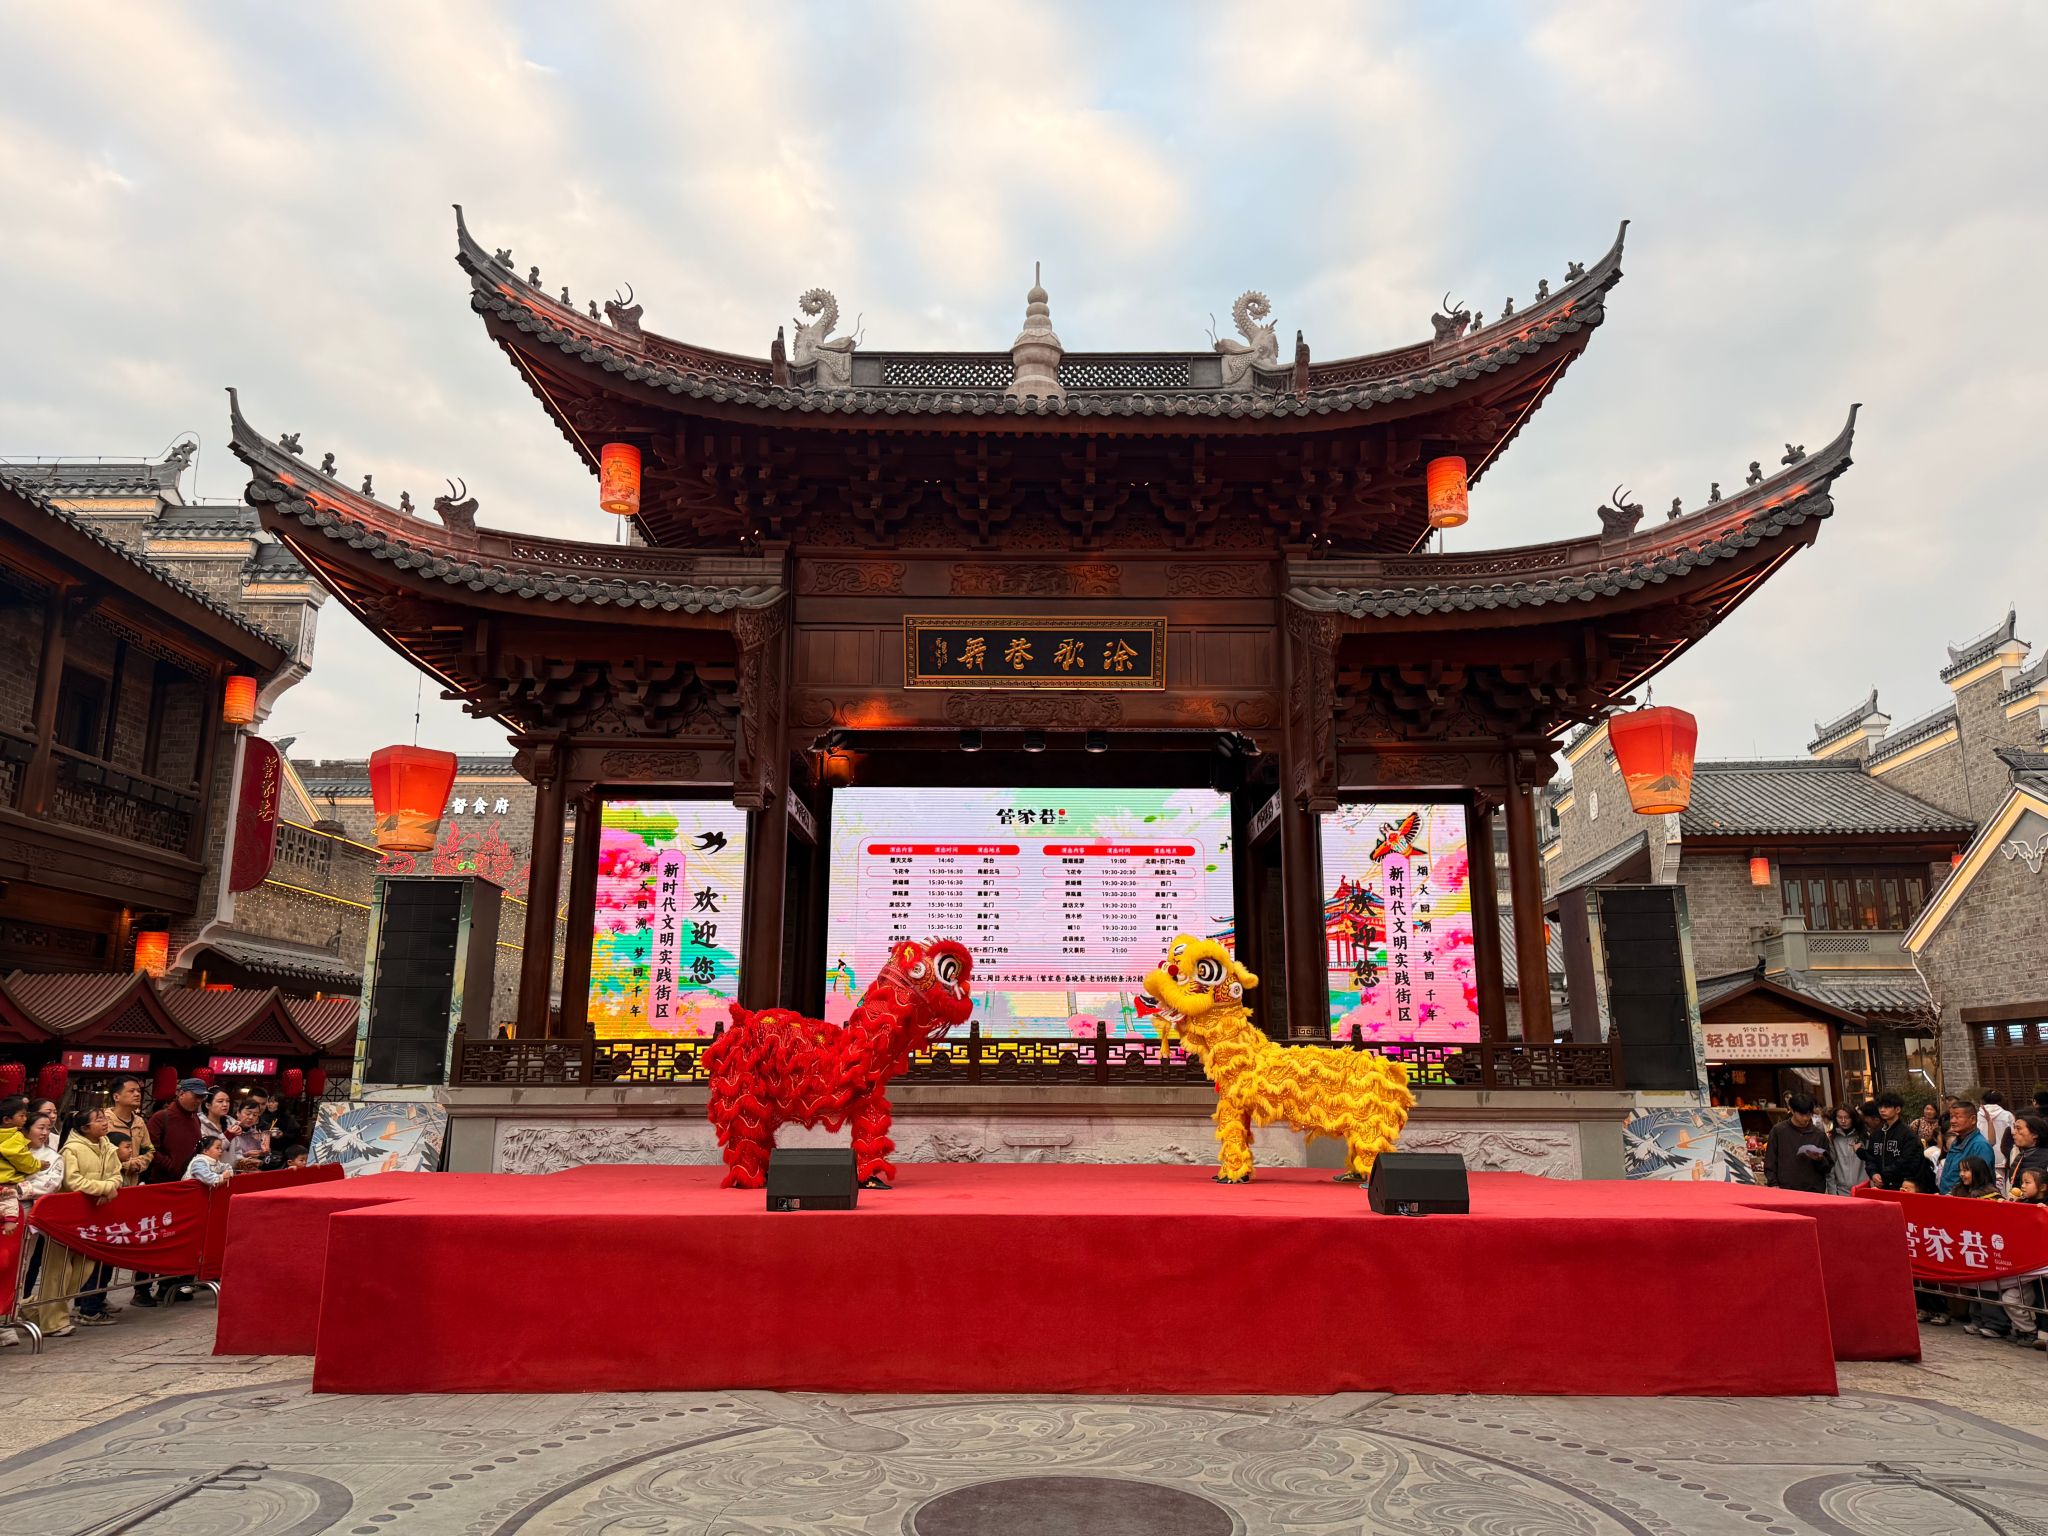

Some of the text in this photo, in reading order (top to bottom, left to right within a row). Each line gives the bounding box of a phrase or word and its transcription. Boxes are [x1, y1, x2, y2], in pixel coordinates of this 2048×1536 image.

[442, 796, 510, 815] 督食府
[996, 808, 1057, 824] 管家巷
[655, 862, 680, 1019] 新时代文明实践街区
[689, 886, 721, 985] 欢迎您
[1348, 886, 1381, 988] 欢迎您
[1388, 865, 1412, 1022] 新时代文明实践街区
[222, 1058, 265, 1074] 少林寺烤面筋
[1706, 1032, 1809, 1048] 轻创3D打印
